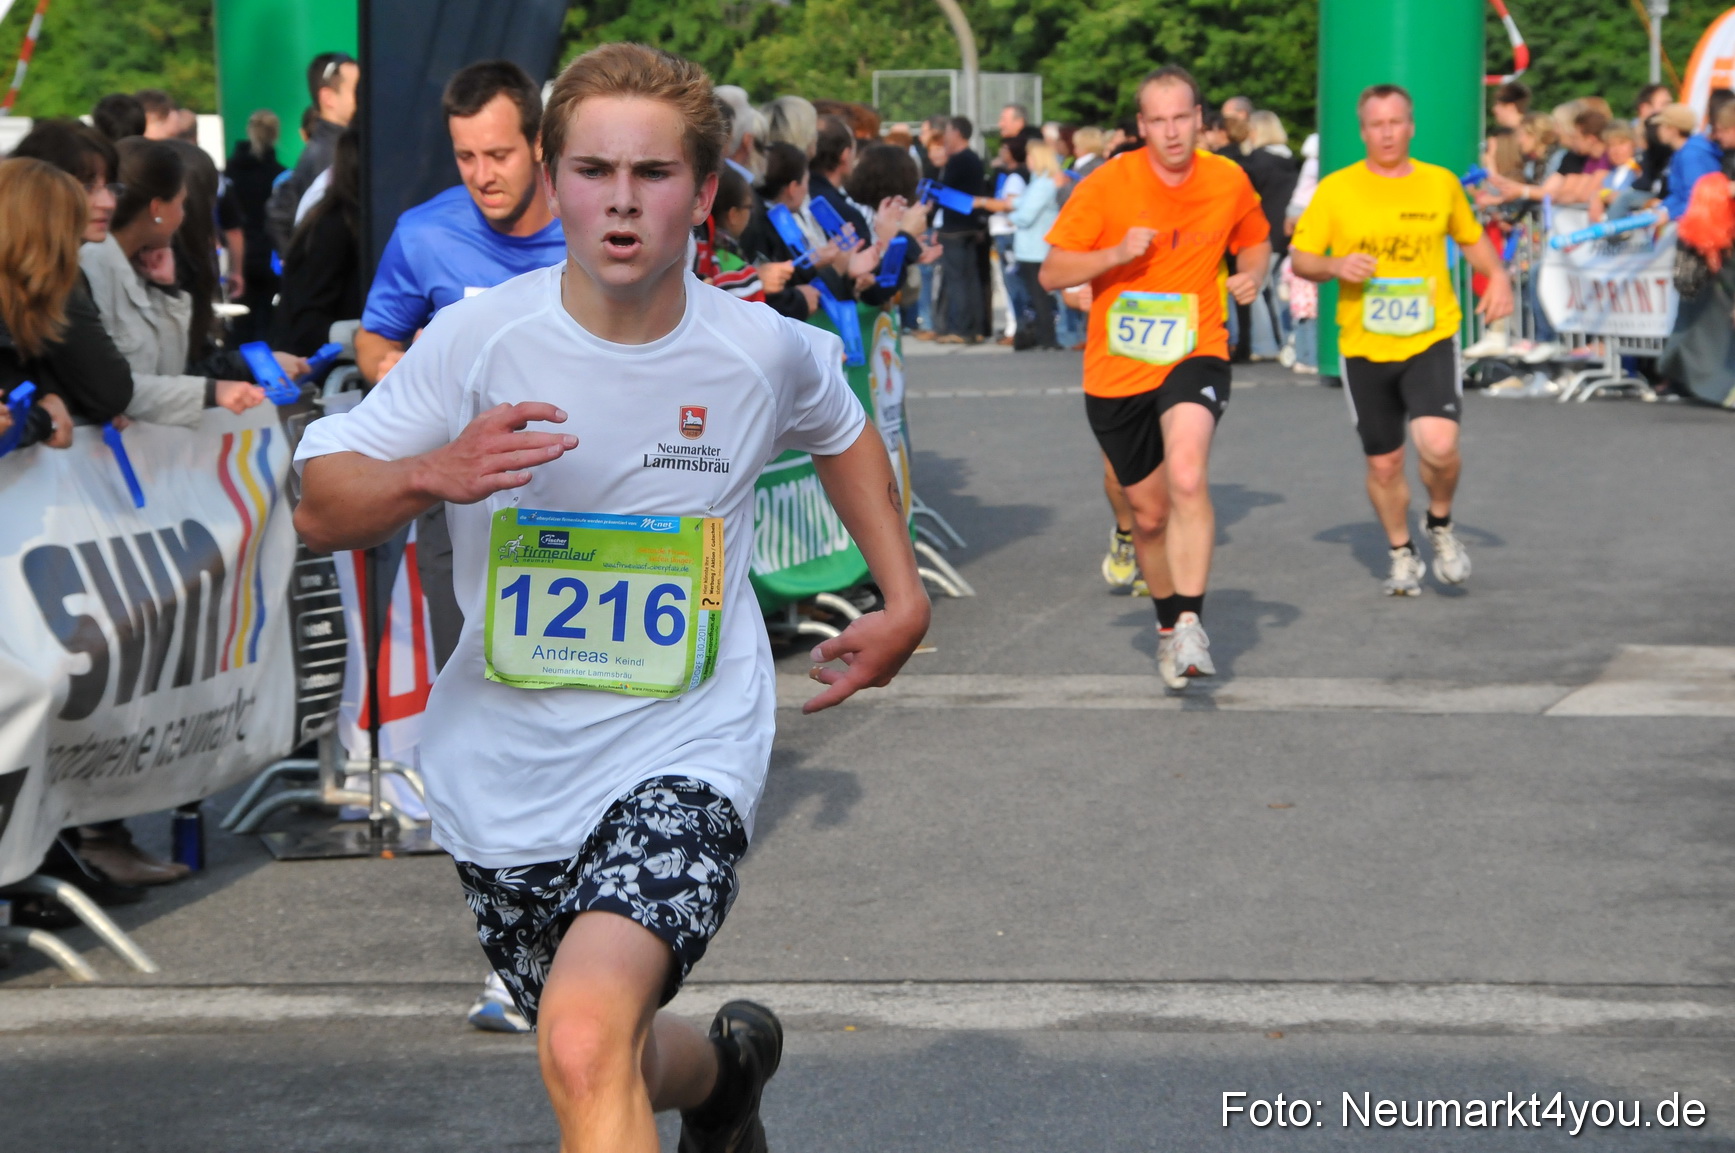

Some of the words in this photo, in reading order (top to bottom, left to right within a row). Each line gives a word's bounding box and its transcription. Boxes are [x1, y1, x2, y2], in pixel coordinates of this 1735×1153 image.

[1371, 298, 1421, 321] 204
[1118, 316, 1178, 346] 577
[657, 443, 721, 456] Neumarkter
[643, 454, 730, 474] Lammsbräu
[640, 518, 677, 531] M-net
[544, 534, 567, 544] Fischer
[523, 545, 597, 562] firmenlauf
[500, 573, 687, 647] 1216
[702, 597, 720, 606] ?
[696, 624, 707, 659] 3.10.2011
[531, 644, 609, 665] Andreas
[615, 656, 645, 667] Keindl
[542, 666, 586, 676] Neumarkter
[587, 669, 633, 679] Lammsbräu
